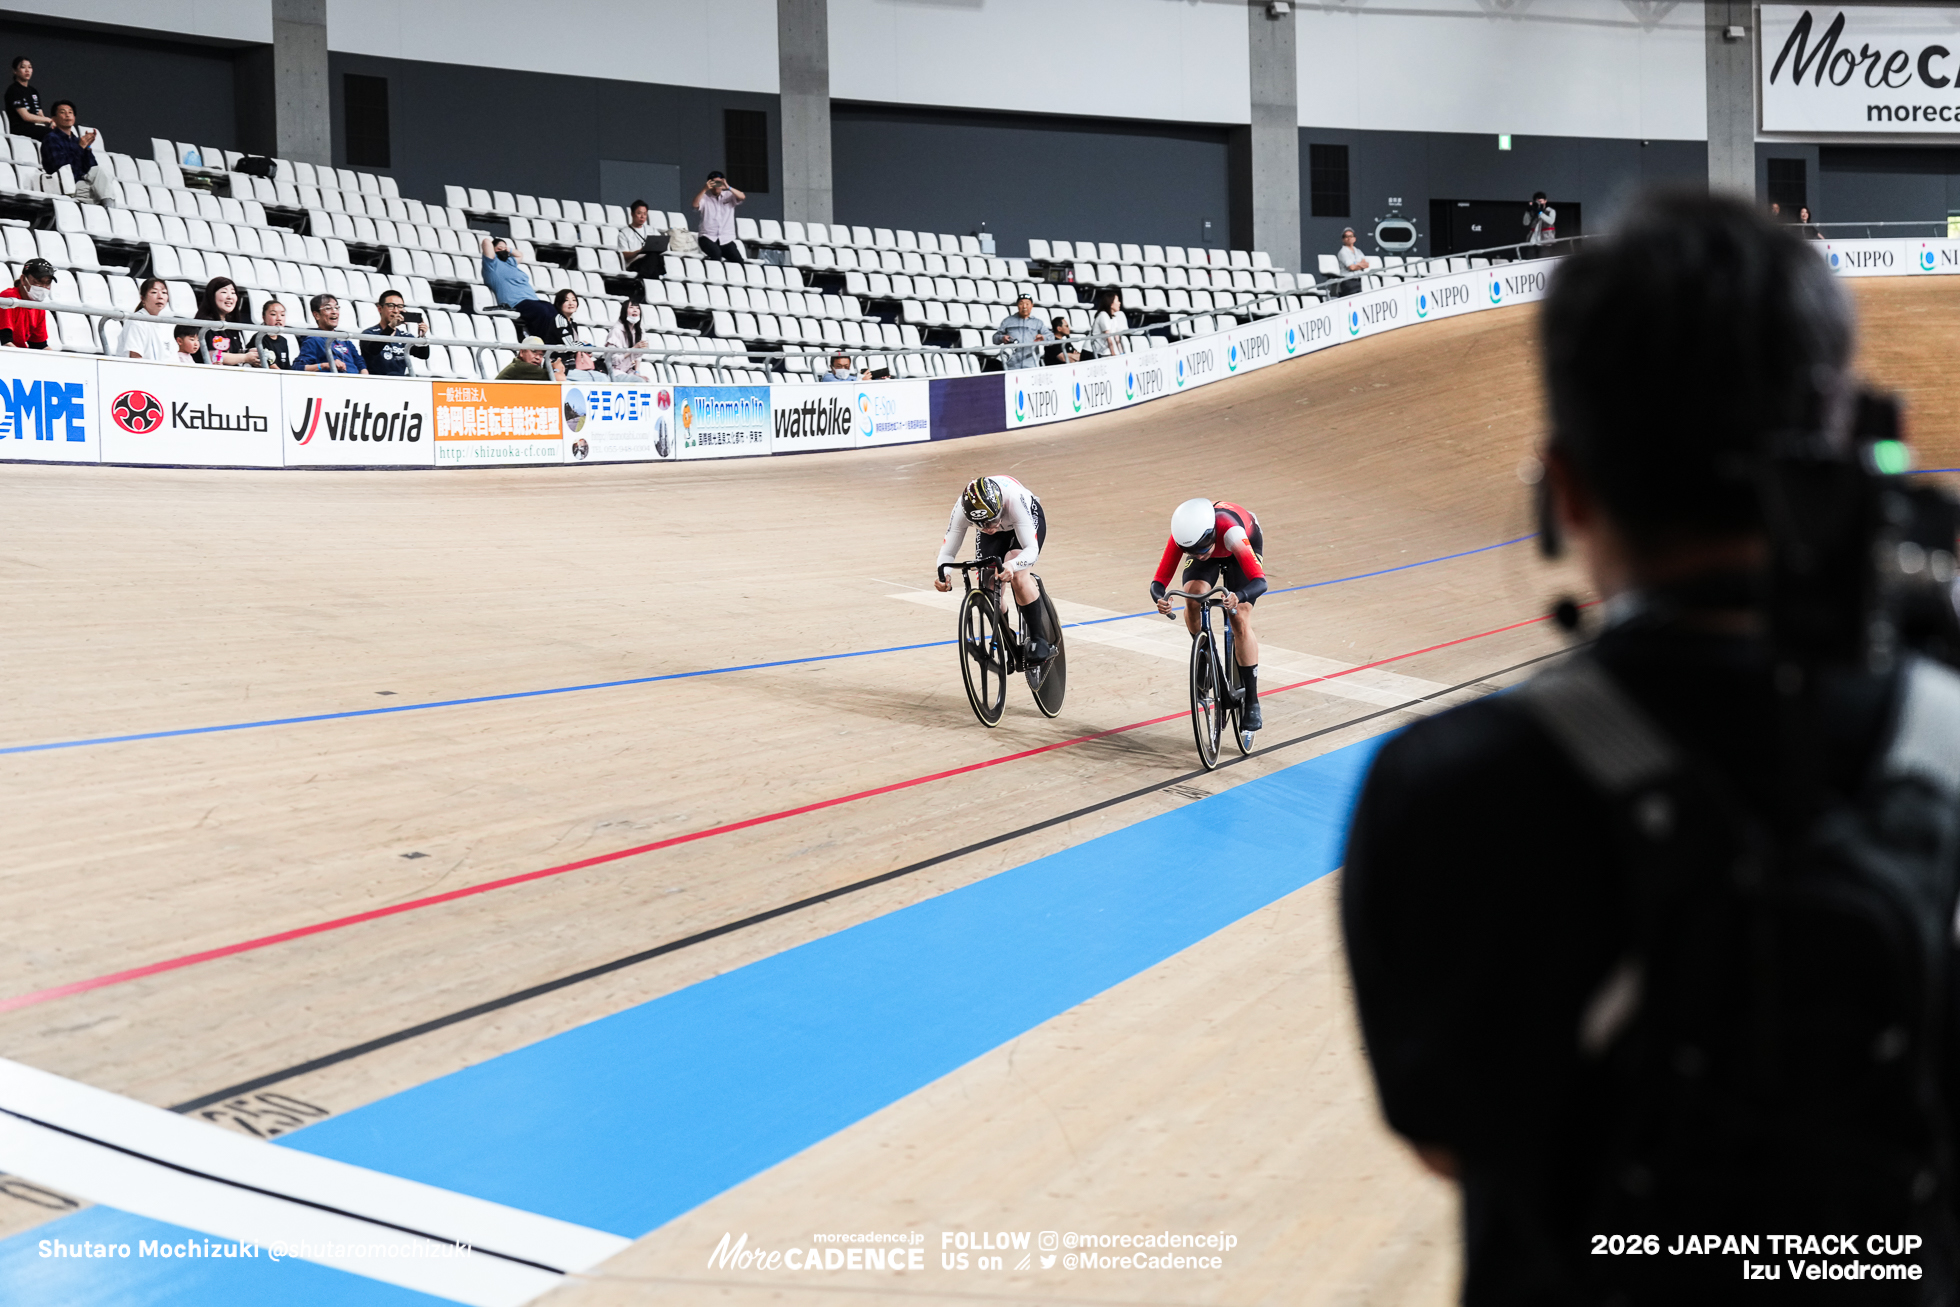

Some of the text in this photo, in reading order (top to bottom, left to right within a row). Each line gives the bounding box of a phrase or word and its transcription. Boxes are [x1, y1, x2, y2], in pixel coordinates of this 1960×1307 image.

[1845, 250, 1894, 268] NIPPO
[1430, 284, 1469, 310] NIPPO
[1504, 271, 1545, 296] NIPPO
[1362, 298, 1398, 327] NIPPO
[1298, 315, 1331, 344] NIPPO
[1239, 333, 1270, 362] NIPPO
[1186, 348, 1214, 377] NIPPO
[437, 387, 488, 403] 一般社団法人
[1084, 379, 1112, 409] NIPPO
[1136, 367, 1163, 397] NIPPO
[172, 401, 268, 433] Kabuto
[587, 389, 651, 422] 伊豆の国市
[695, 396, 764, 428] Welcome to Ito
[774, 397, 851, 438] wattbike
[1027, 389, 1058, 419] NIPPO
[325, 400, 423, 443] vittoria
